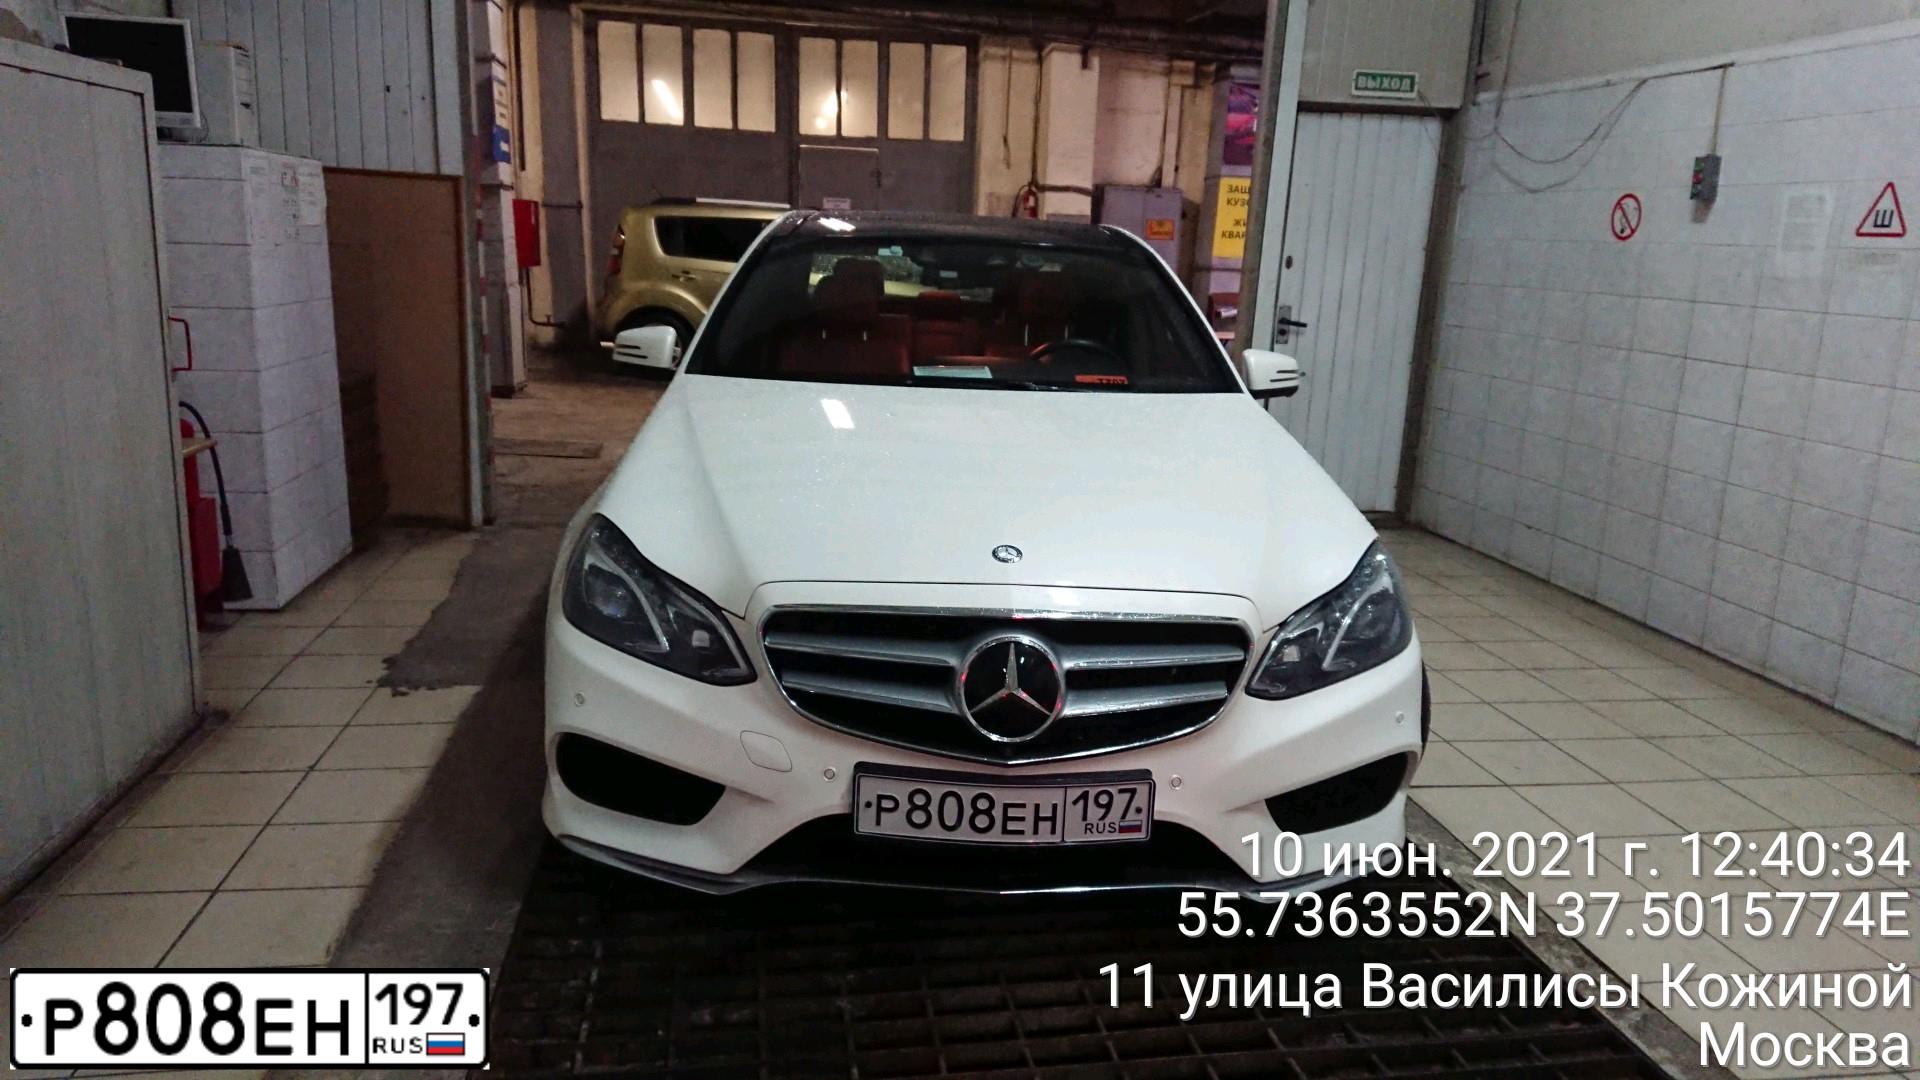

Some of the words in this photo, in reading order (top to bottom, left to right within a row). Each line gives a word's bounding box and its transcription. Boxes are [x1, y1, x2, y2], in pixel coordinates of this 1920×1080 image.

[1357, 75, 1412, 92] ВЫХОД
[1873, 209, 1894, 228] Ш
[875, 787, 1057, 836] Р808ЕН
[1071, 787, 1138, 822] 197
[1083, 822, 1117, 835] RUS
